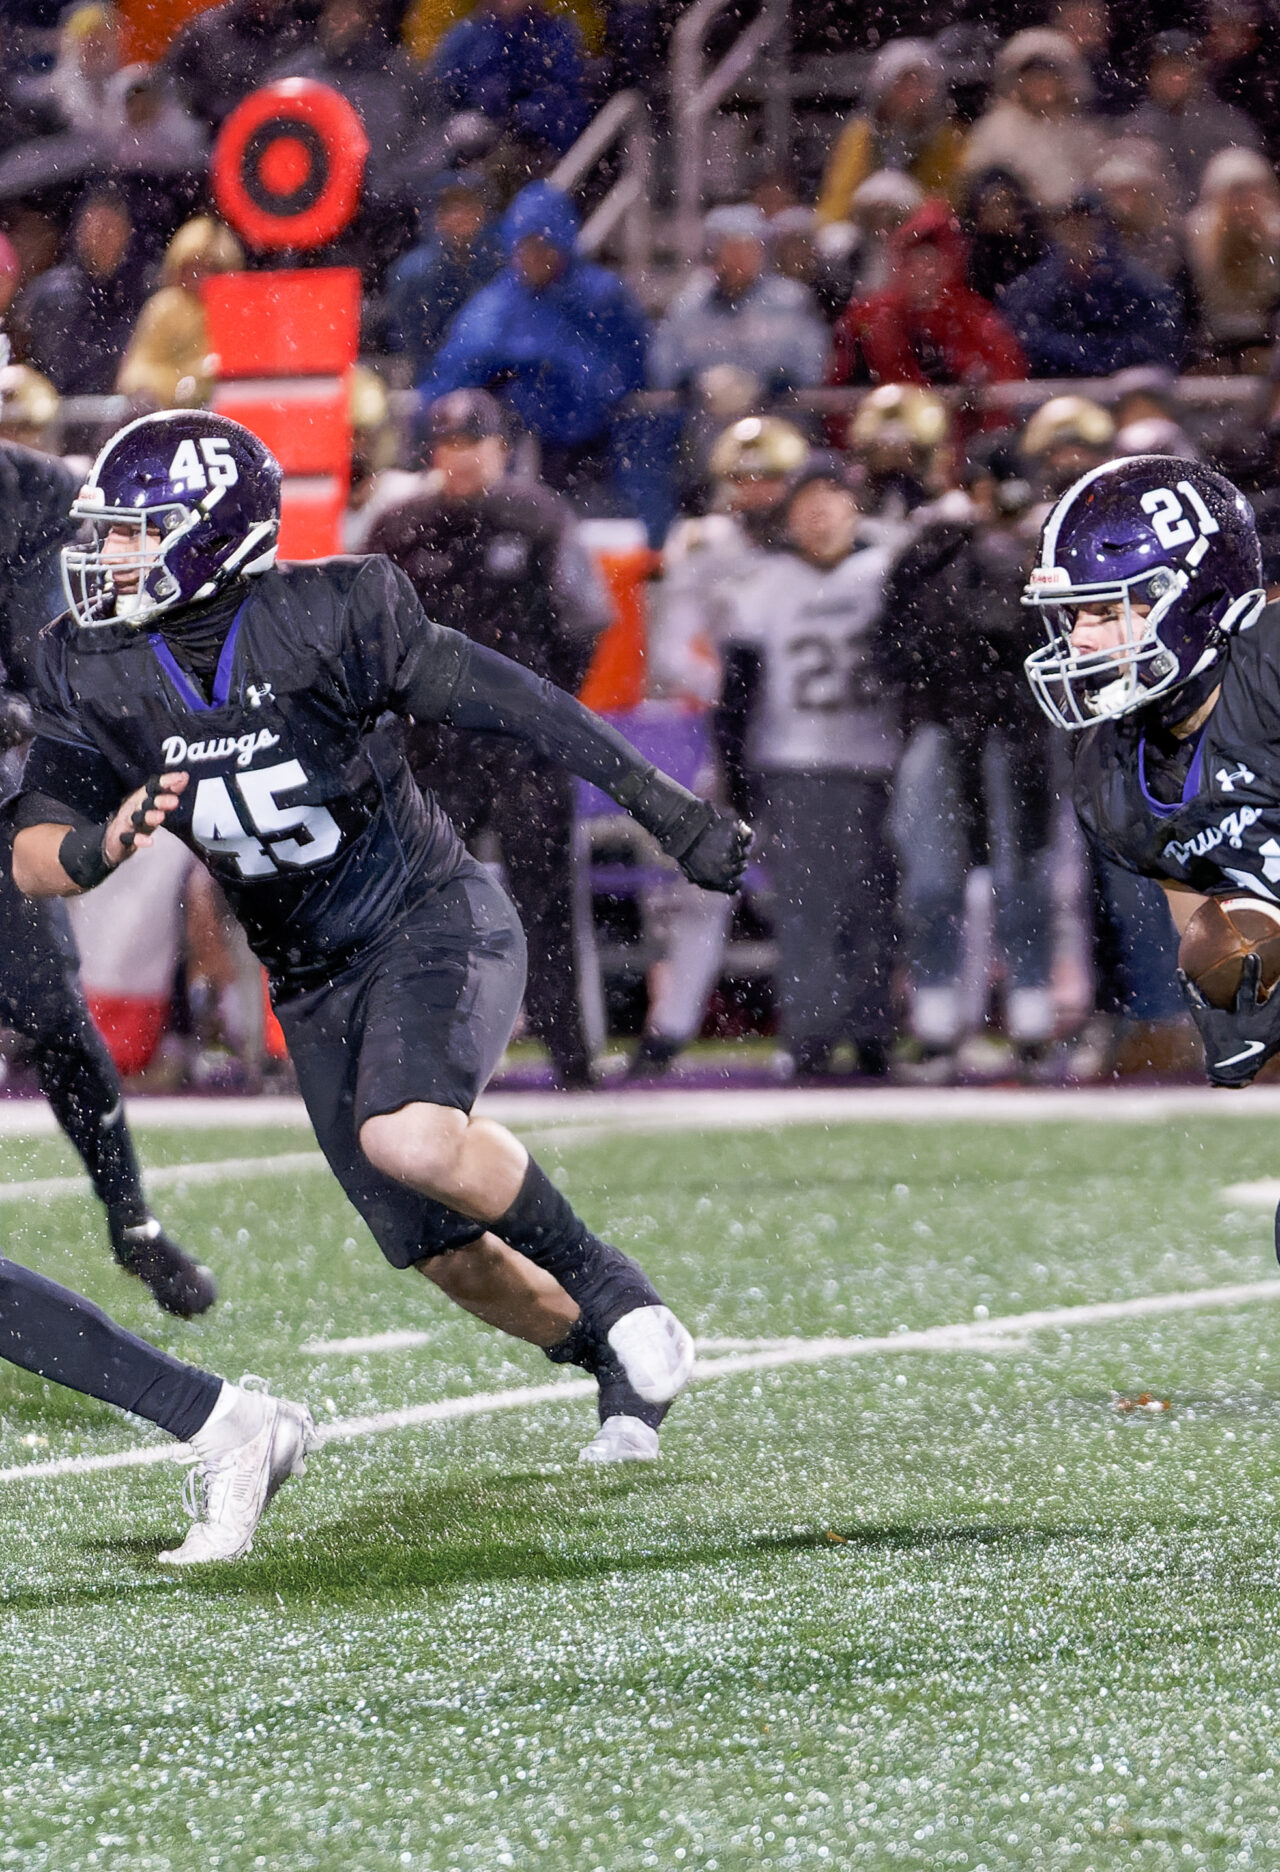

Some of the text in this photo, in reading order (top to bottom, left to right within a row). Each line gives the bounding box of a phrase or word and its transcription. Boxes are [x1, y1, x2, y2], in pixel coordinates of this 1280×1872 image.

[169, 437, 239, 490] 45
[1140, 480, 1220, 549] 21
[161, 728, 281, 766] Dawgs
[191, 758, 342, 876] 45
